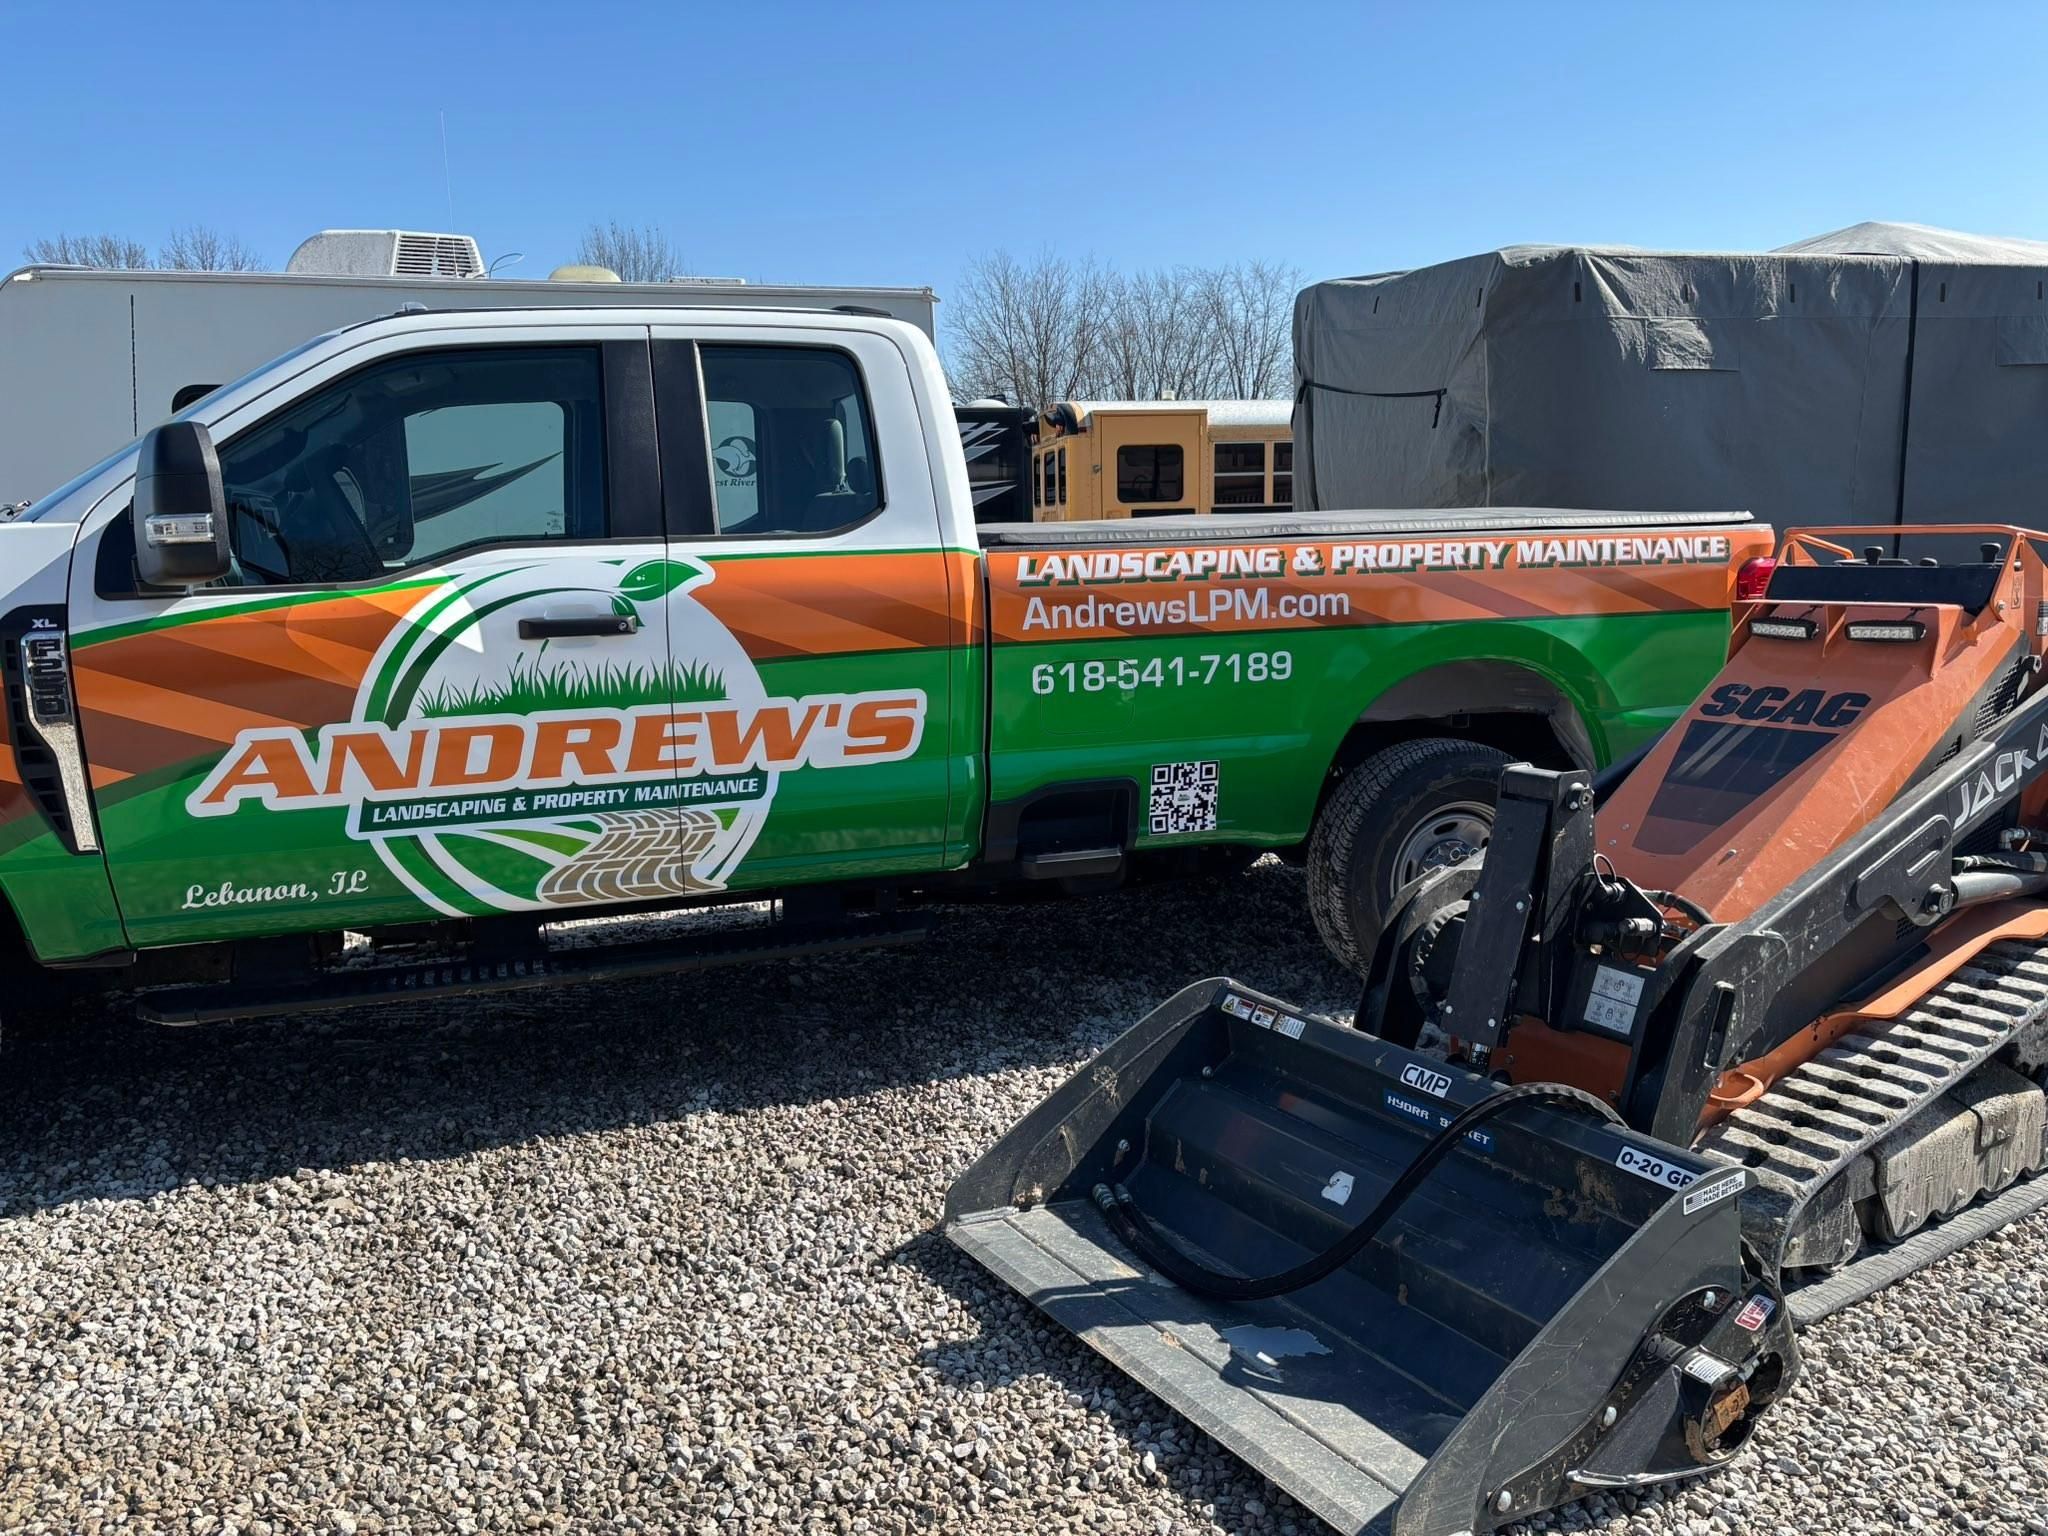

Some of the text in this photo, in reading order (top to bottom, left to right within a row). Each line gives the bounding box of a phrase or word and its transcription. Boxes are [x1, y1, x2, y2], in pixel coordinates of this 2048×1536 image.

[730, 478, 756, 487] River
[1016, 536, 1729, 587] LANDSCAPING & PROPERTY MAINTENANCE
[32, 618, 58, 629] XL
[1022, 587, 1351, 631] AndrewsLPM.com
[1032, 651, 1293, 695] 618-541-7189
[1699, 683, 1872, 729] SCAG
[198, 696, 919, 806] ANDREW'S
[1953, 723, 2048, 831] JACKA
[372, 778, 759, 823] LANDSCAPING & PROPERTY MAINTENANCE
[181, 869, 369, 910] Lebanon, IL
[1403, 1065, 1450, 1094] CMP
[1387, 1095, 1429, 1120] HYDRA
[1620, 1151, 1694, 1188] 0-20 GP
